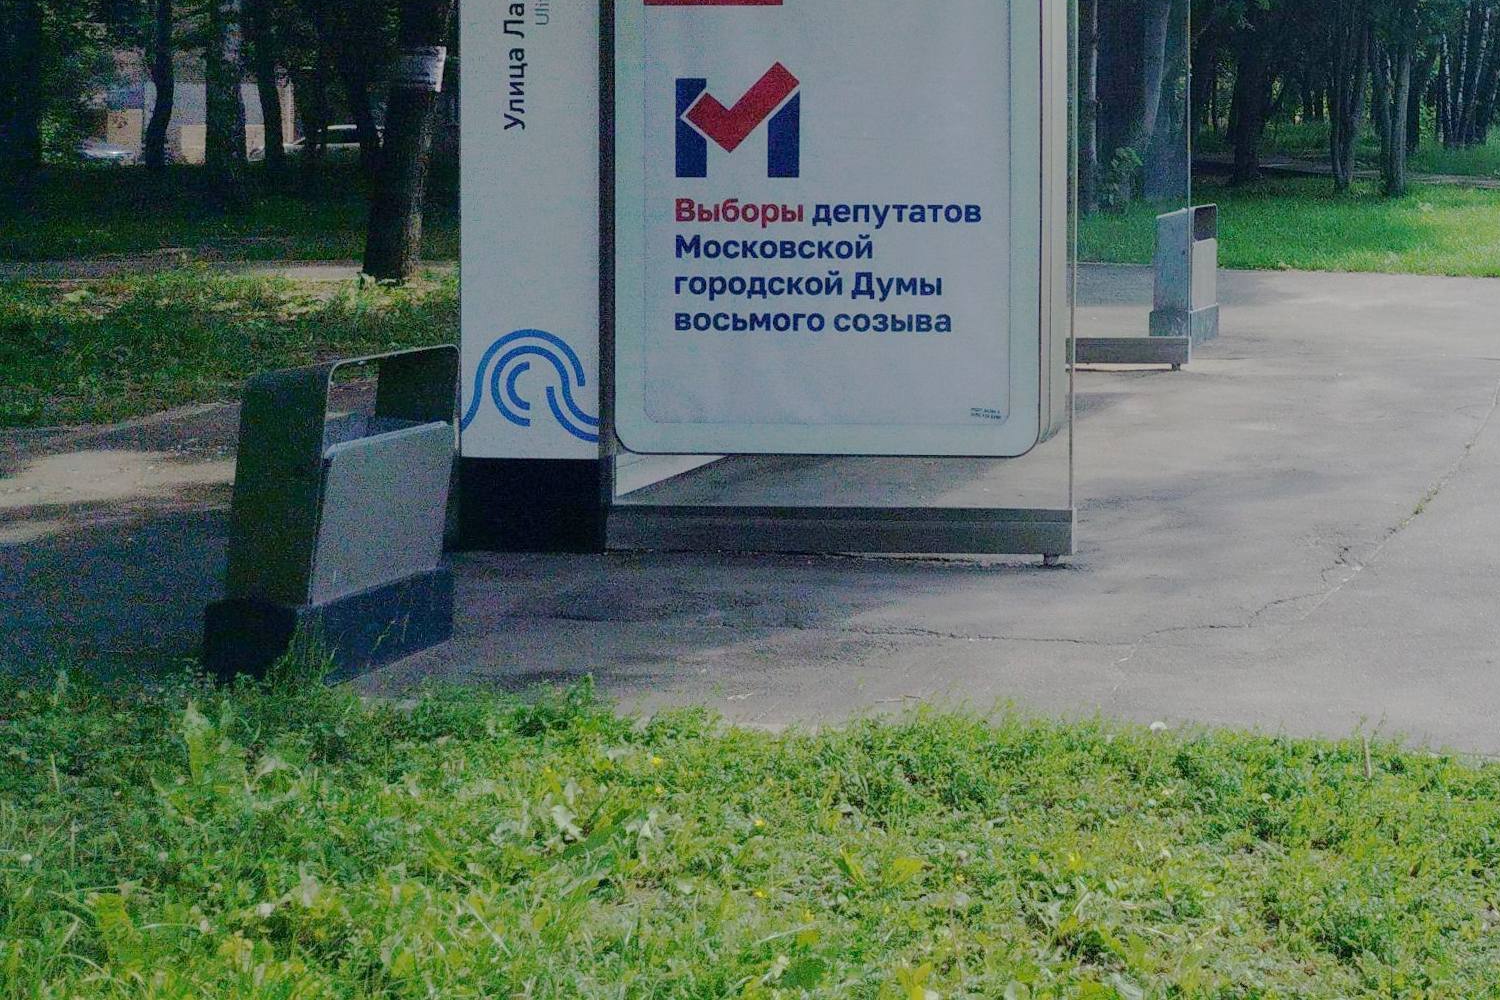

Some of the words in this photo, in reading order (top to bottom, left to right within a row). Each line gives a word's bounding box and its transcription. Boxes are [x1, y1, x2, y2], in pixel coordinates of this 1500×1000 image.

[503, 47, 527, 130] Улица
[675, 197, 804, 229] Выборы
[812, 203, 982, 230] депутатов
[675, 233, 873, 260] Московской
[674, 270, 843, 301] городской
[851, 271, 943, 302] Думы
[674, 312, 825, 333] восьмого
[833, 312, 952, 334] созыва
